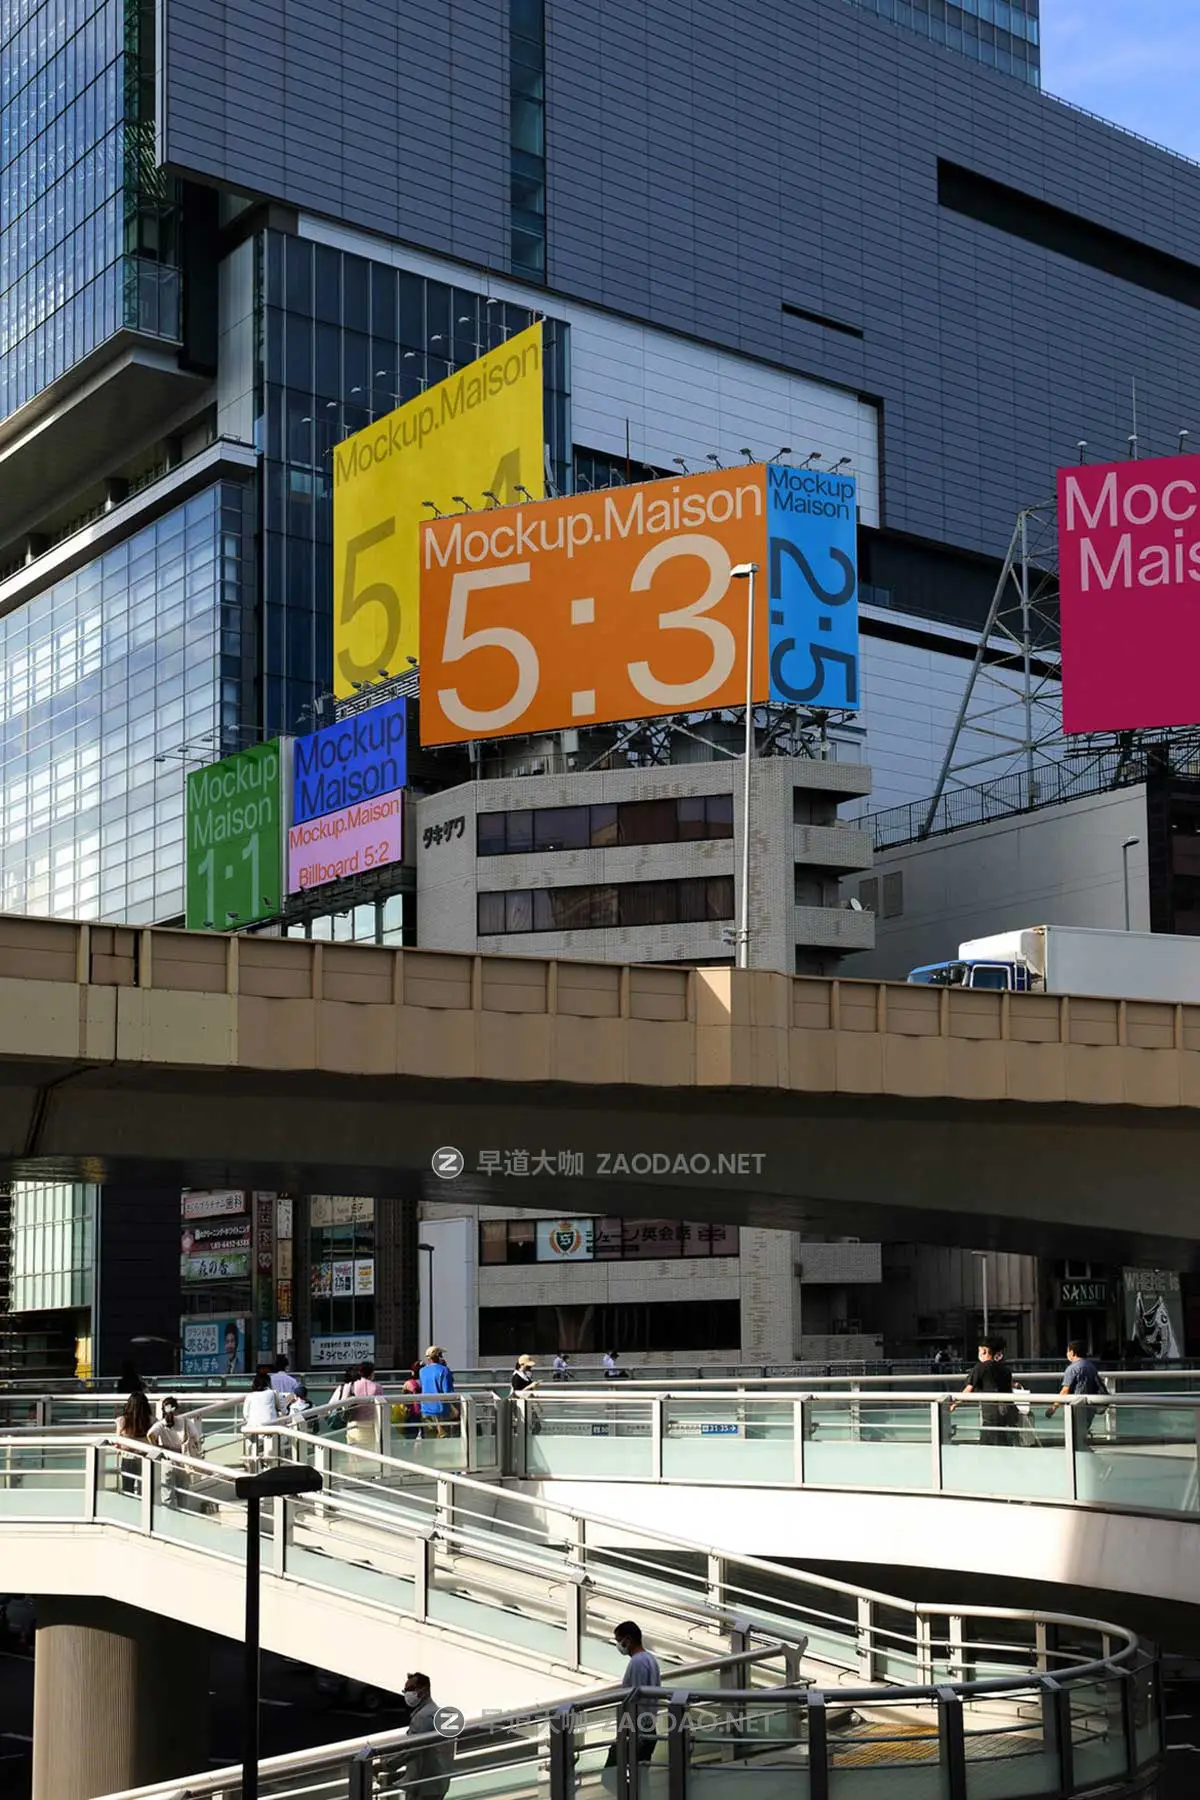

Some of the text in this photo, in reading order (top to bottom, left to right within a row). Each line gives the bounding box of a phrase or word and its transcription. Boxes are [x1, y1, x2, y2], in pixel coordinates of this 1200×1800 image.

[335, 340, 539, 487] Mockup.Maison
[768, 465, 855, 501] Mockup
[774, 492, 850, 520] Maison
[425, 483, 761, 570] Mockup.Maison
[296, 712, 404, 780] Mockup
[190, 754, 277, 811] Mockup
[301, 758, 398, 818] Maison
[194, 797, 272, 850] Maison
[290, 799, 399, 849] Mockup.Maison
[299, 841, 389, 888] Billboard 5:2
